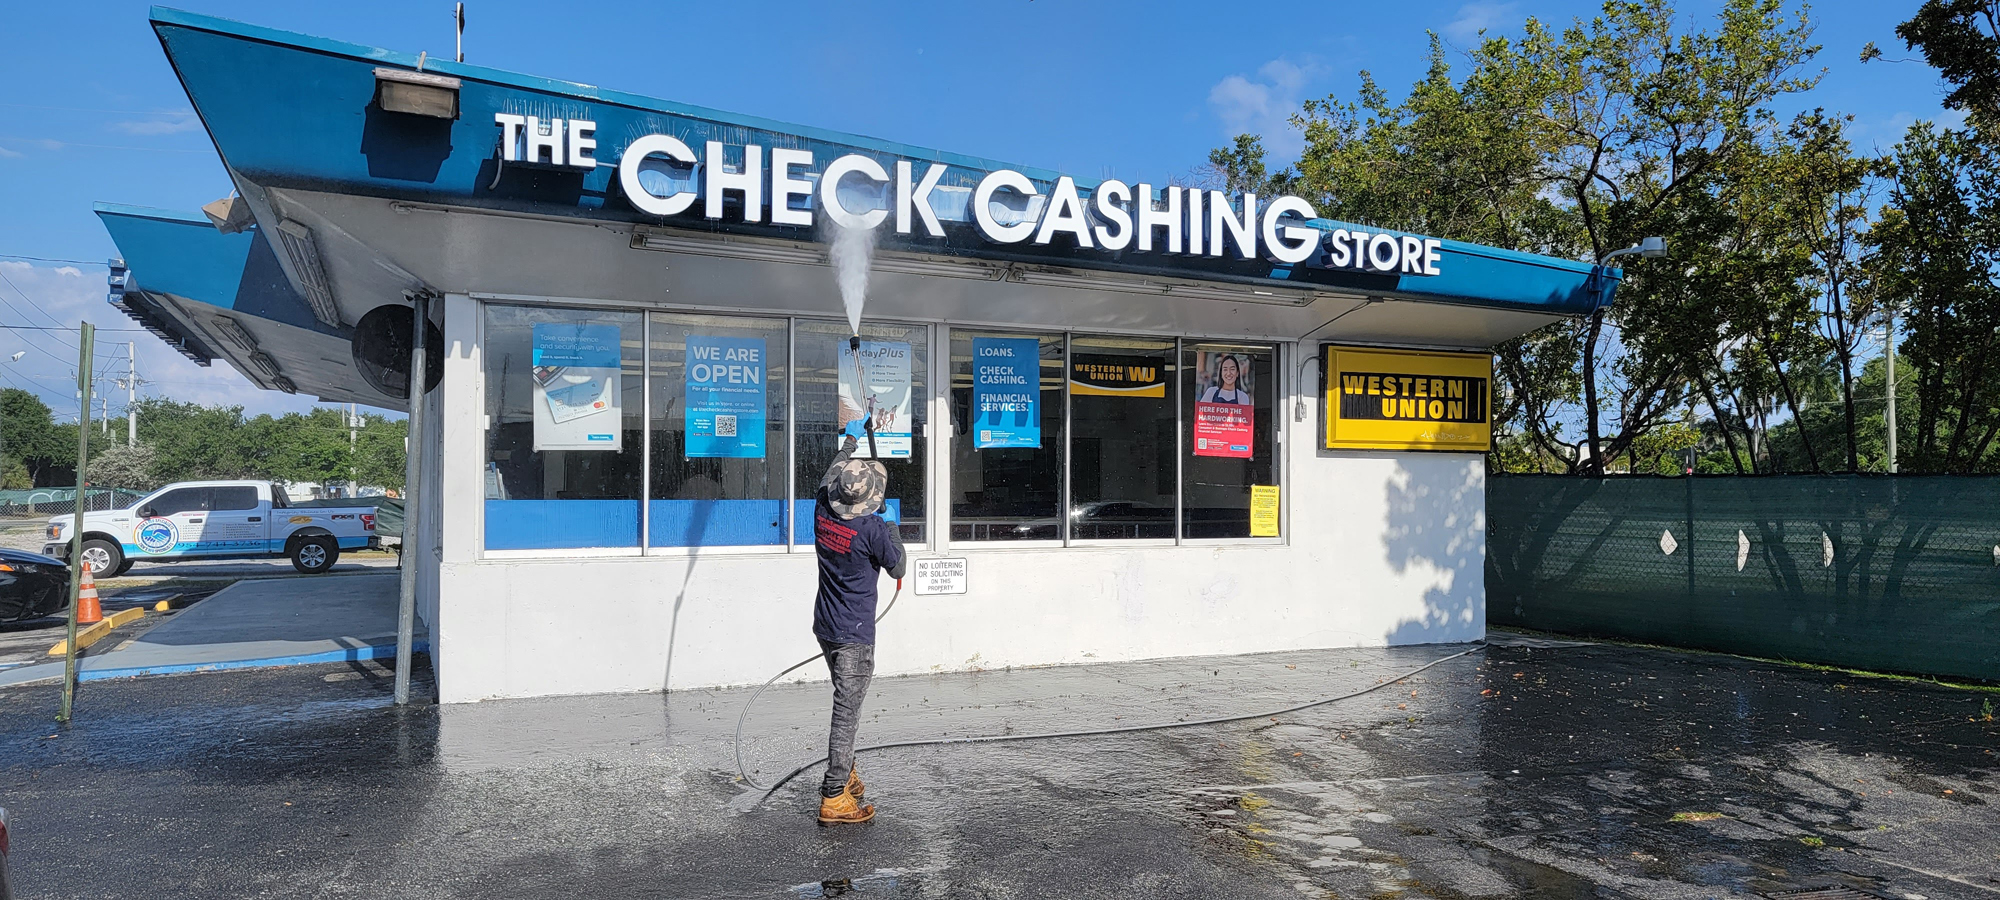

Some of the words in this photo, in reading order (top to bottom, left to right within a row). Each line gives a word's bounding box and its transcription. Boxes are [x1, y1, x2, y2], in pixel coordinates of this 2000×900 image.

[494, 112, 597, 168] THE
[619, 133, 948, 237] CHECK
[973, 169, 1320, 263] CASHING
[1331, 229, 1441, 276] STORE
[557, 335, 600, 343] convenience
[554, 343, 580, 351] security
[979, 347, 1015, 357] LOANS.
[692, 345, 720, 361] WE
[724, 347, 759, 362] ARE
[844, 347, 905, 359] PadayPlus
[979, 365, 1014, 375] CHECK
[1074, 363, 1123, 373] WESTERN
[691, 363, 760, 384] OPEN
[1090, 372, 1123, 380] UNION
[1128, 366, 1155, 382] WU
[979, 375, 1028, 385] CASHING.
[1342, 375, 1463, 398] WESTERN
[980, 393, 1033, 403] FINANCIAL
[980, 402, 1029, 412] SERVICES.
[1381, 398, 1463, 420] UNION
[1198, 414, 1249, 424] HARDWORKING.
[931, 560, 962, 570] LOITERING
[930, 569, 964, 578] SOLICITING
